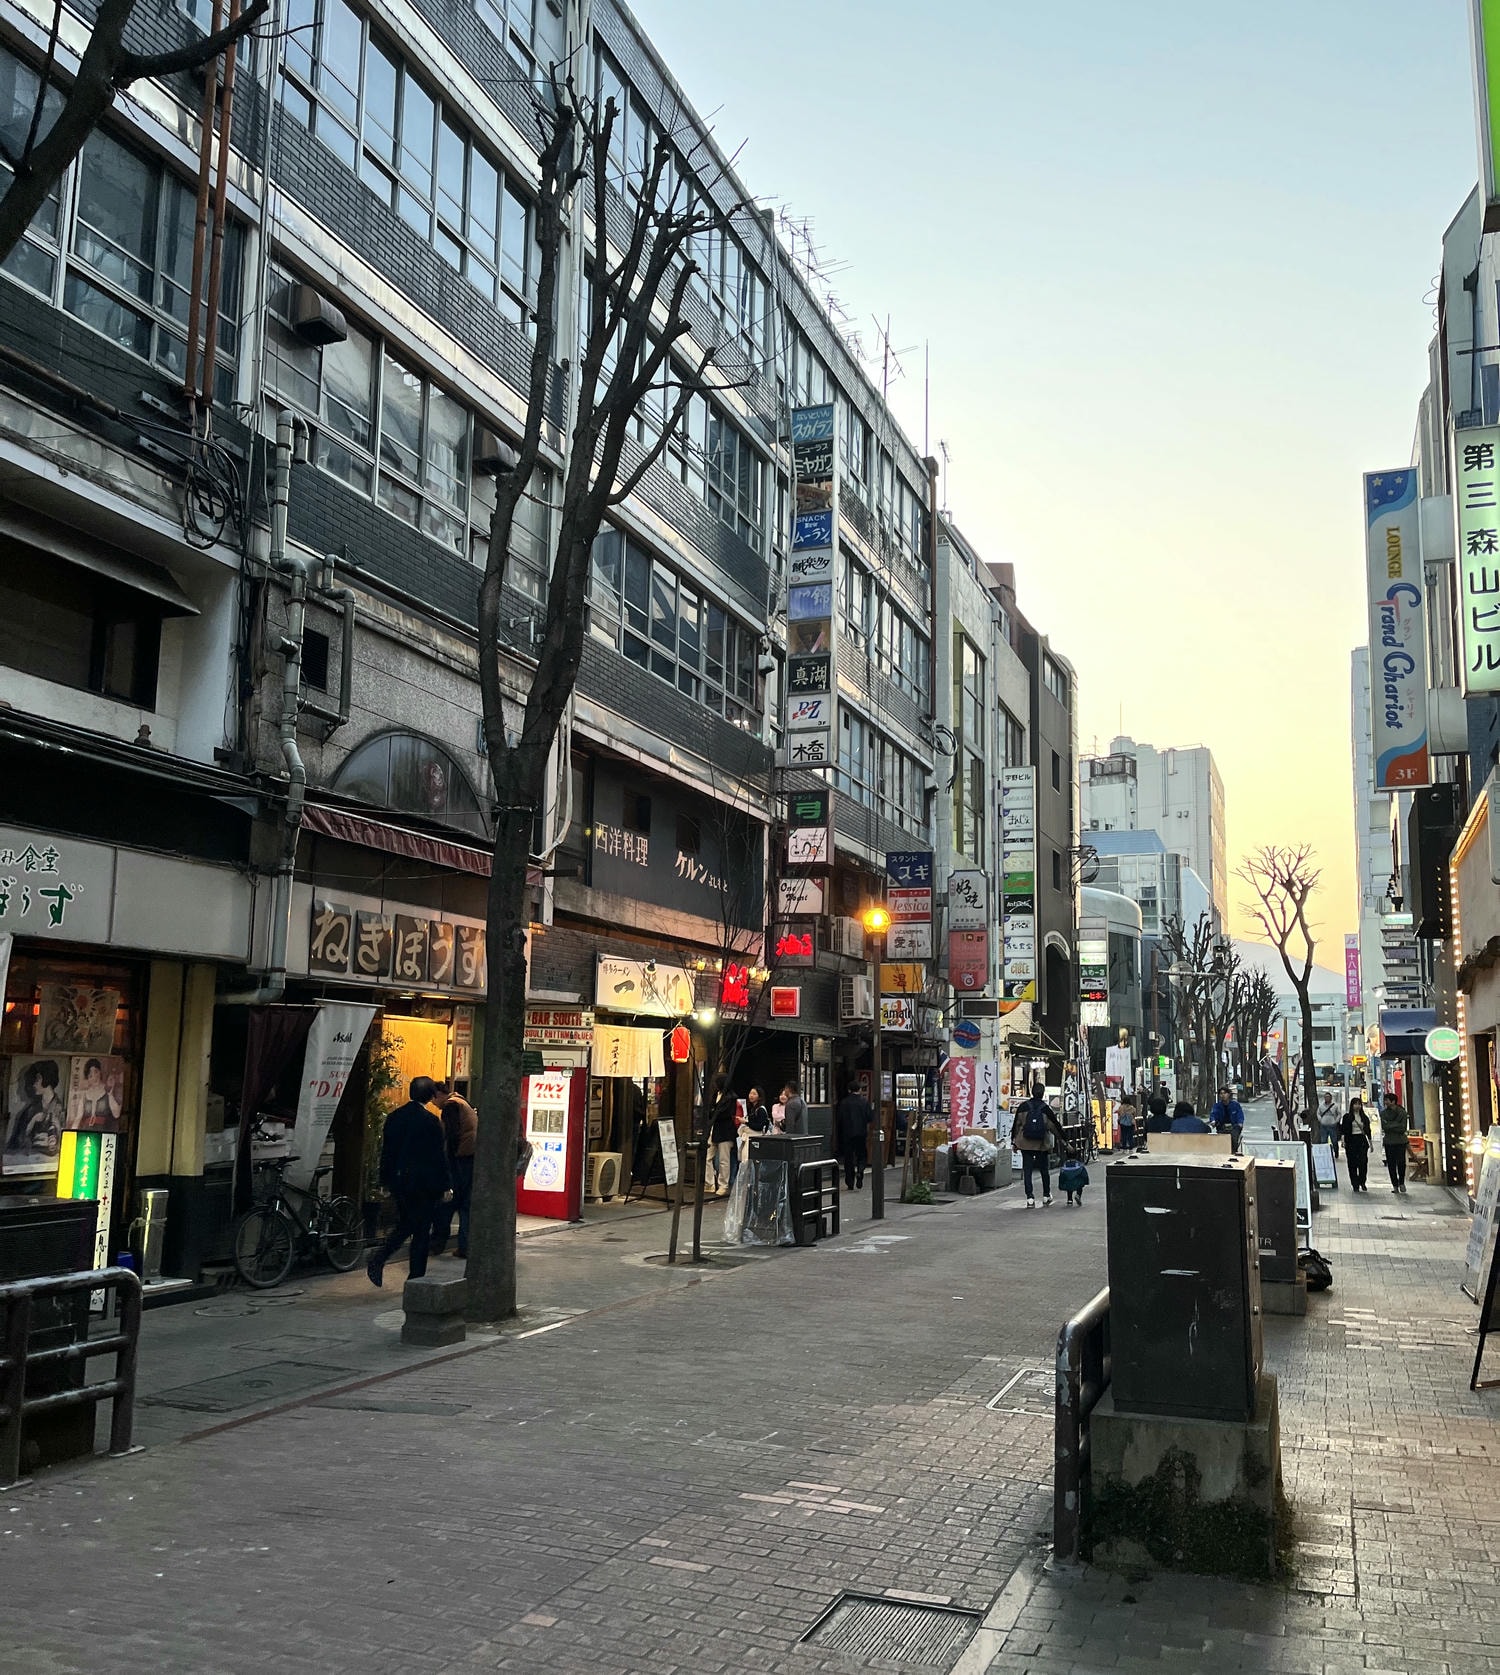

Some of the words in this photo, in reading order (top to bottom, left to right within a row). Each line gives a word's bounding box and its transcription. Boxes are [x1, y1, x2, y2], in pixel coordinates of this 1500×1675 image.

[1387, 527, 1402, 579] LOUNGE
[1463, 442, 1500, 672] 第三森山ビル
[1383, 651, 1415, 730] Chariot
[1394, 768, 1418, 780] 3F
[594, 821, 649, 868] 西洋料理
[674, 849, 709, 885] ケルン
[892, 899, 930, 912] Jessica
[531, 1012, 551, 1025] BAR
[552, 1012, 582, 1026] SOUTH
[534, 1082, 566, 1093] ケルン
[545, 1142, 562, 1152] 2F
